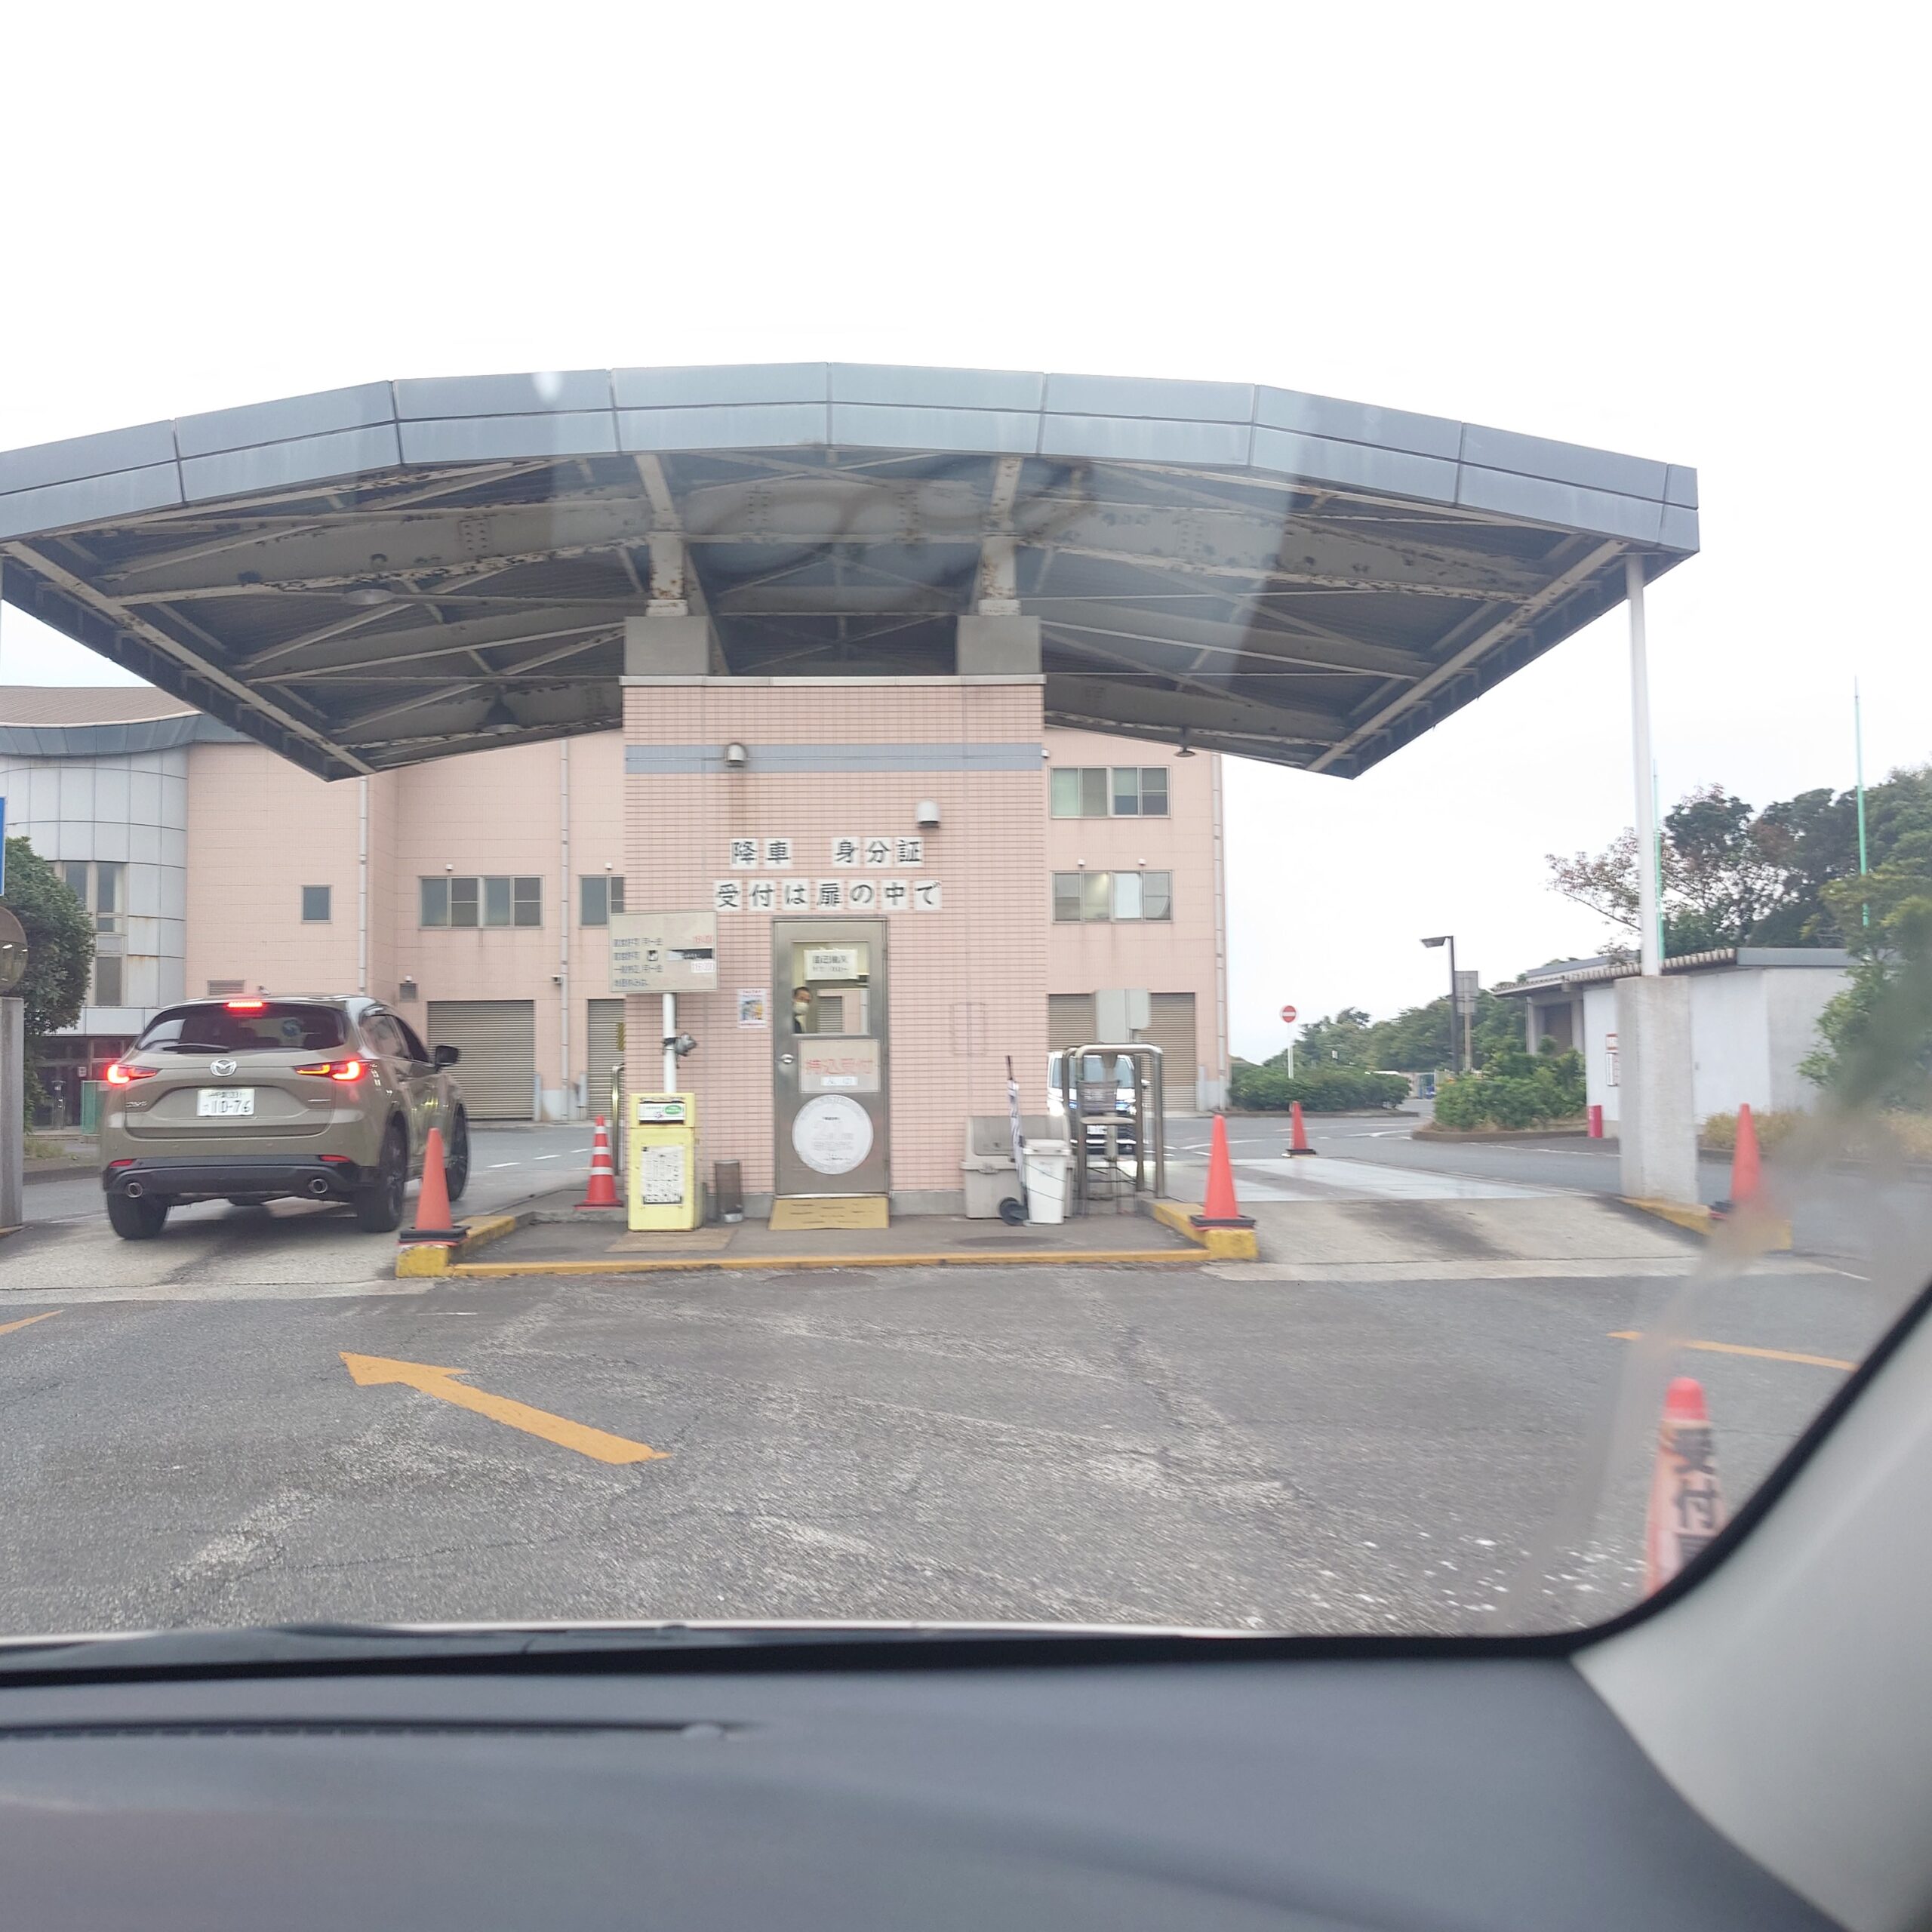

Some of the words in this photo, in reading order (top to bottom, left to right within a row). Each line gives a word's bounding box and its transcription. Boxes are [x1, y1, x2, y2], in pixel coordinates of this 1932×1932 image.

[731, 840, 790, 864] 降車
[835, 838, 922, 863] 身分証
[717, 881, 940, 907] 受付は扉の中で
